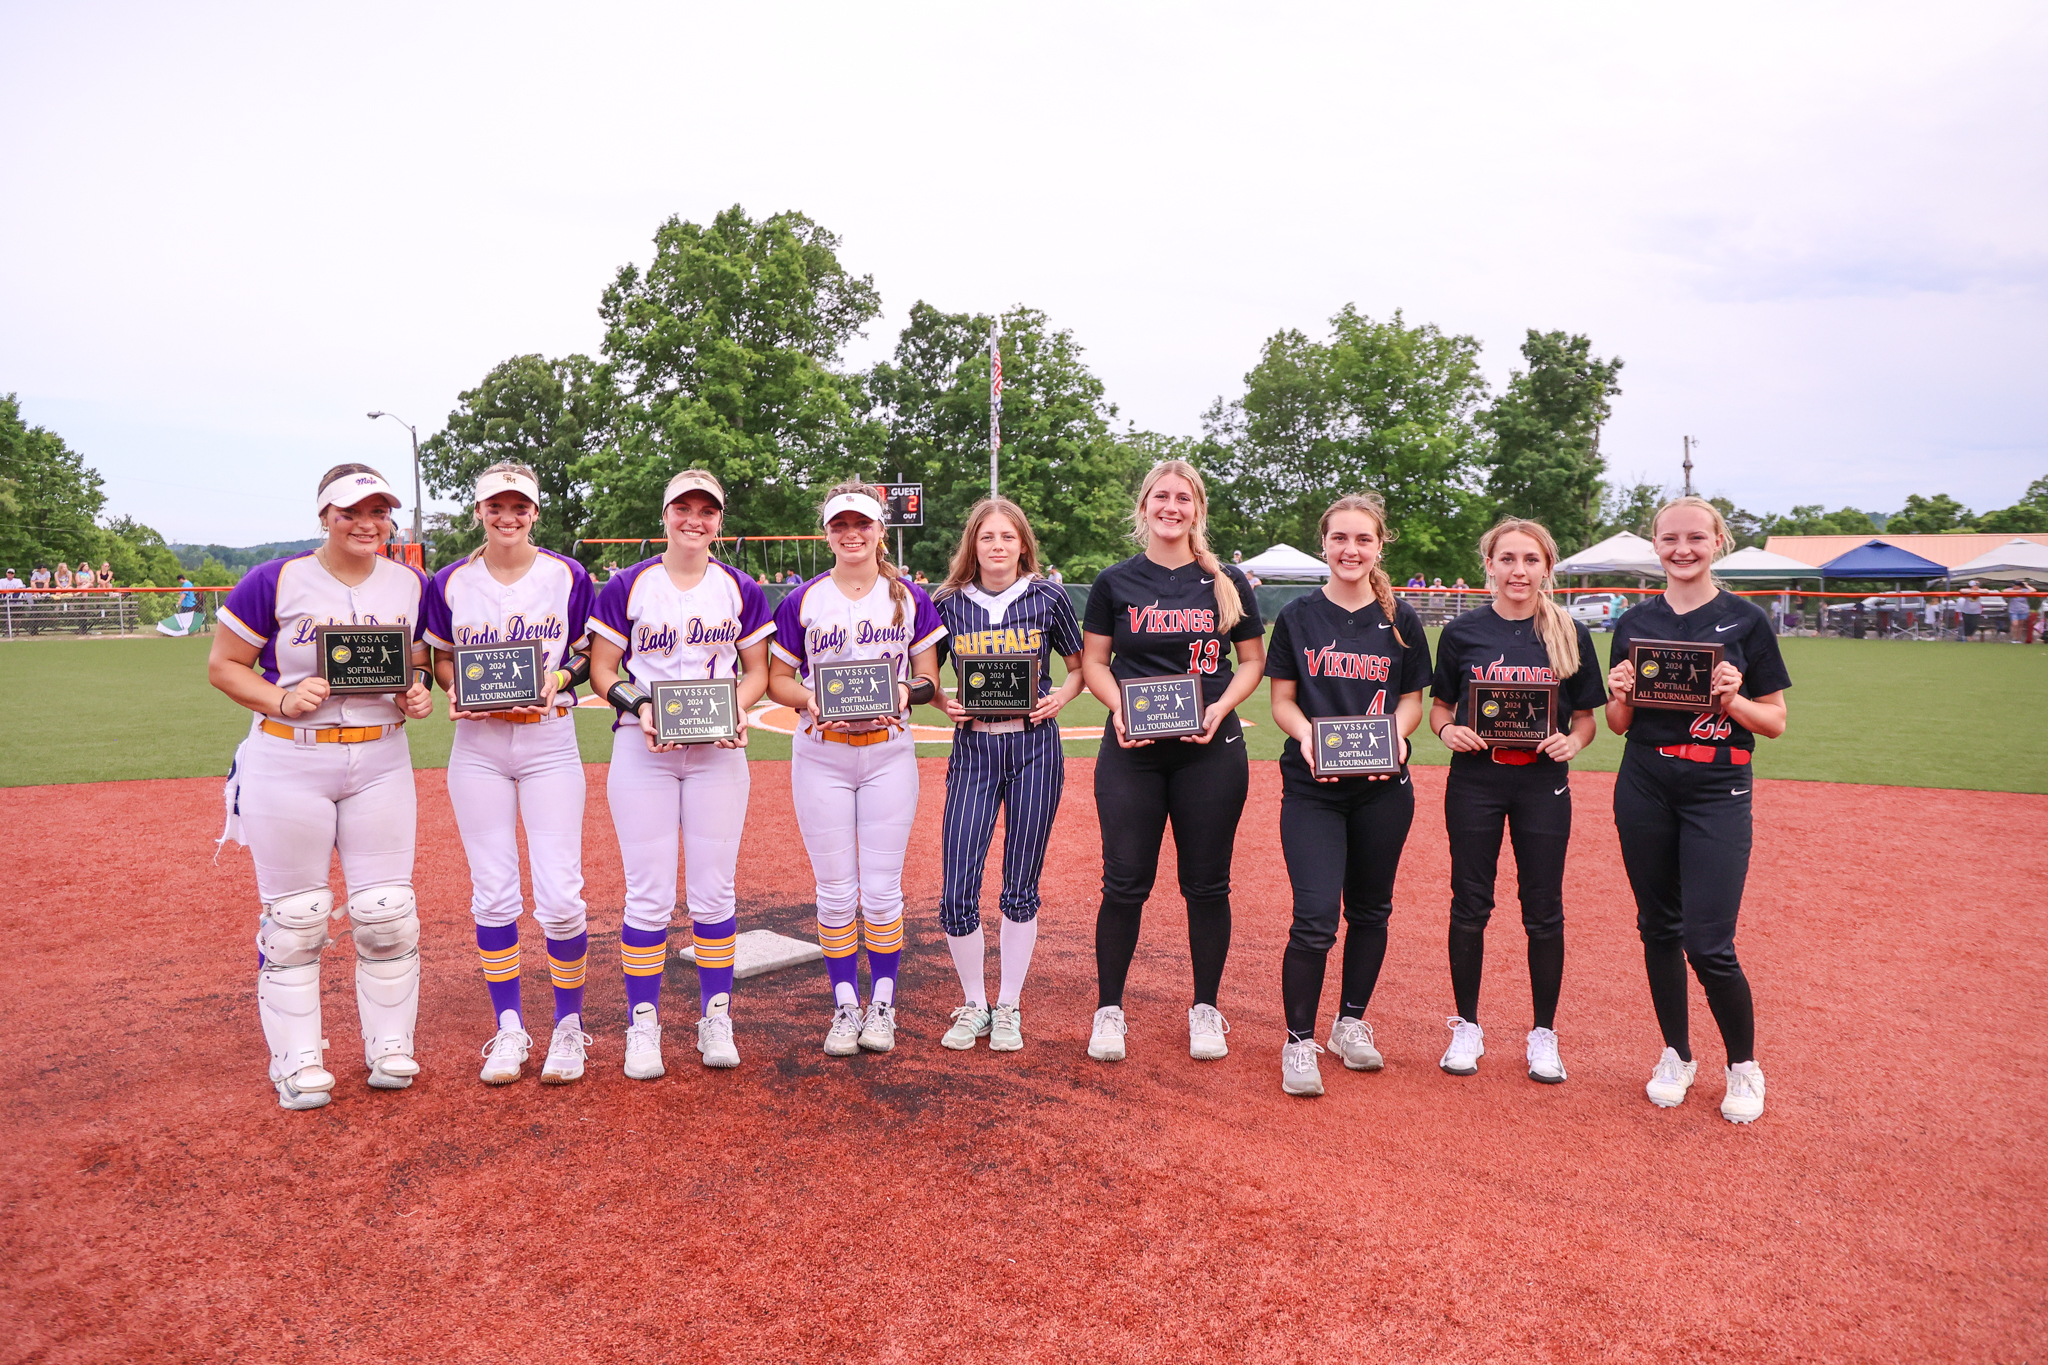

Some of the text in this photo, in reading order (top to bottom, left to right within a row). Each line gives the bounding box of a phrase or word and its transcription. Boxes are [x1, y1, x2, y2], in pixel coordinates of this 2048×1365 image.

[891, 487, 920, 496] GUEST
[908, 495, 919, 512] 2
[1128, 599, 1214, 633] VIKINGS
[505, 614, 563, 641] Devils
[341, 635, 389, 643] WVSSAC
[637, 616, 737, 656] Lady Devils
[810, 619, 906, 655] Lady Devils
[954, 628, 1042, 654] BUFFALO
[474, 651, 520, 661] WVSSAC
[1187, 639, 1220, 674] 13
[1651, 651, 1698, 660] WVSSAC
[1304, 639, 1391, 682] VIKINGS
[346, 666, 386, 674] SOFTBALL
[488, 662, 506, 670] 2024
[1665, 662, 1683, 670] 2024
[834, 668, 876, 677] WVSSAC
[331, 676, 401, 685] ALL TOURNAMENT
[480, 681, 517, 691] SOFTBALL
[1140, 684, 1181, 694] WVSSAC
[1653, 682, 1692, 691] SOFTBALL
[465, 690, 533, 702] ALL TOURNAMENT
[673, 688, 716, 697] WVSSAC
[980, 690, 1014, 698] SOFTBALL
[1491, 691, 1536, 700] WVSSAC
[1638, 690, 1708, 703] ALL TOURNAMENT
[840, 695, 875, 704] SOFTBALL
[1153, 694, 1170, 702] 2024
[967, 699, 1027, 707] ALL TOURNAMENT
[1504, 701, 1521, 709] 2024
[827, 702, 889, 714] ALL TOURNAMENT
[679, 717, 714, 725] SOFTBALL
[1146, 712, 1180, 721] SOFTBALL
[1134, 720, 1195, 732] ALL TOURNAMENT
[1333, 723, 1376, 731] WVSSAC
[1494, 720, 1530, 729] SOFTBALL
[679, 725, 729, 735] TOURNAMENT
[1480, 729, 1545, 738] ALL TOURNAMENT
[1346, 732, 1363, 740] 2024
[1338, 750, 1374, 758] SOFTBALL
[1339, 758, 1389, 767] TOURNAMENT
